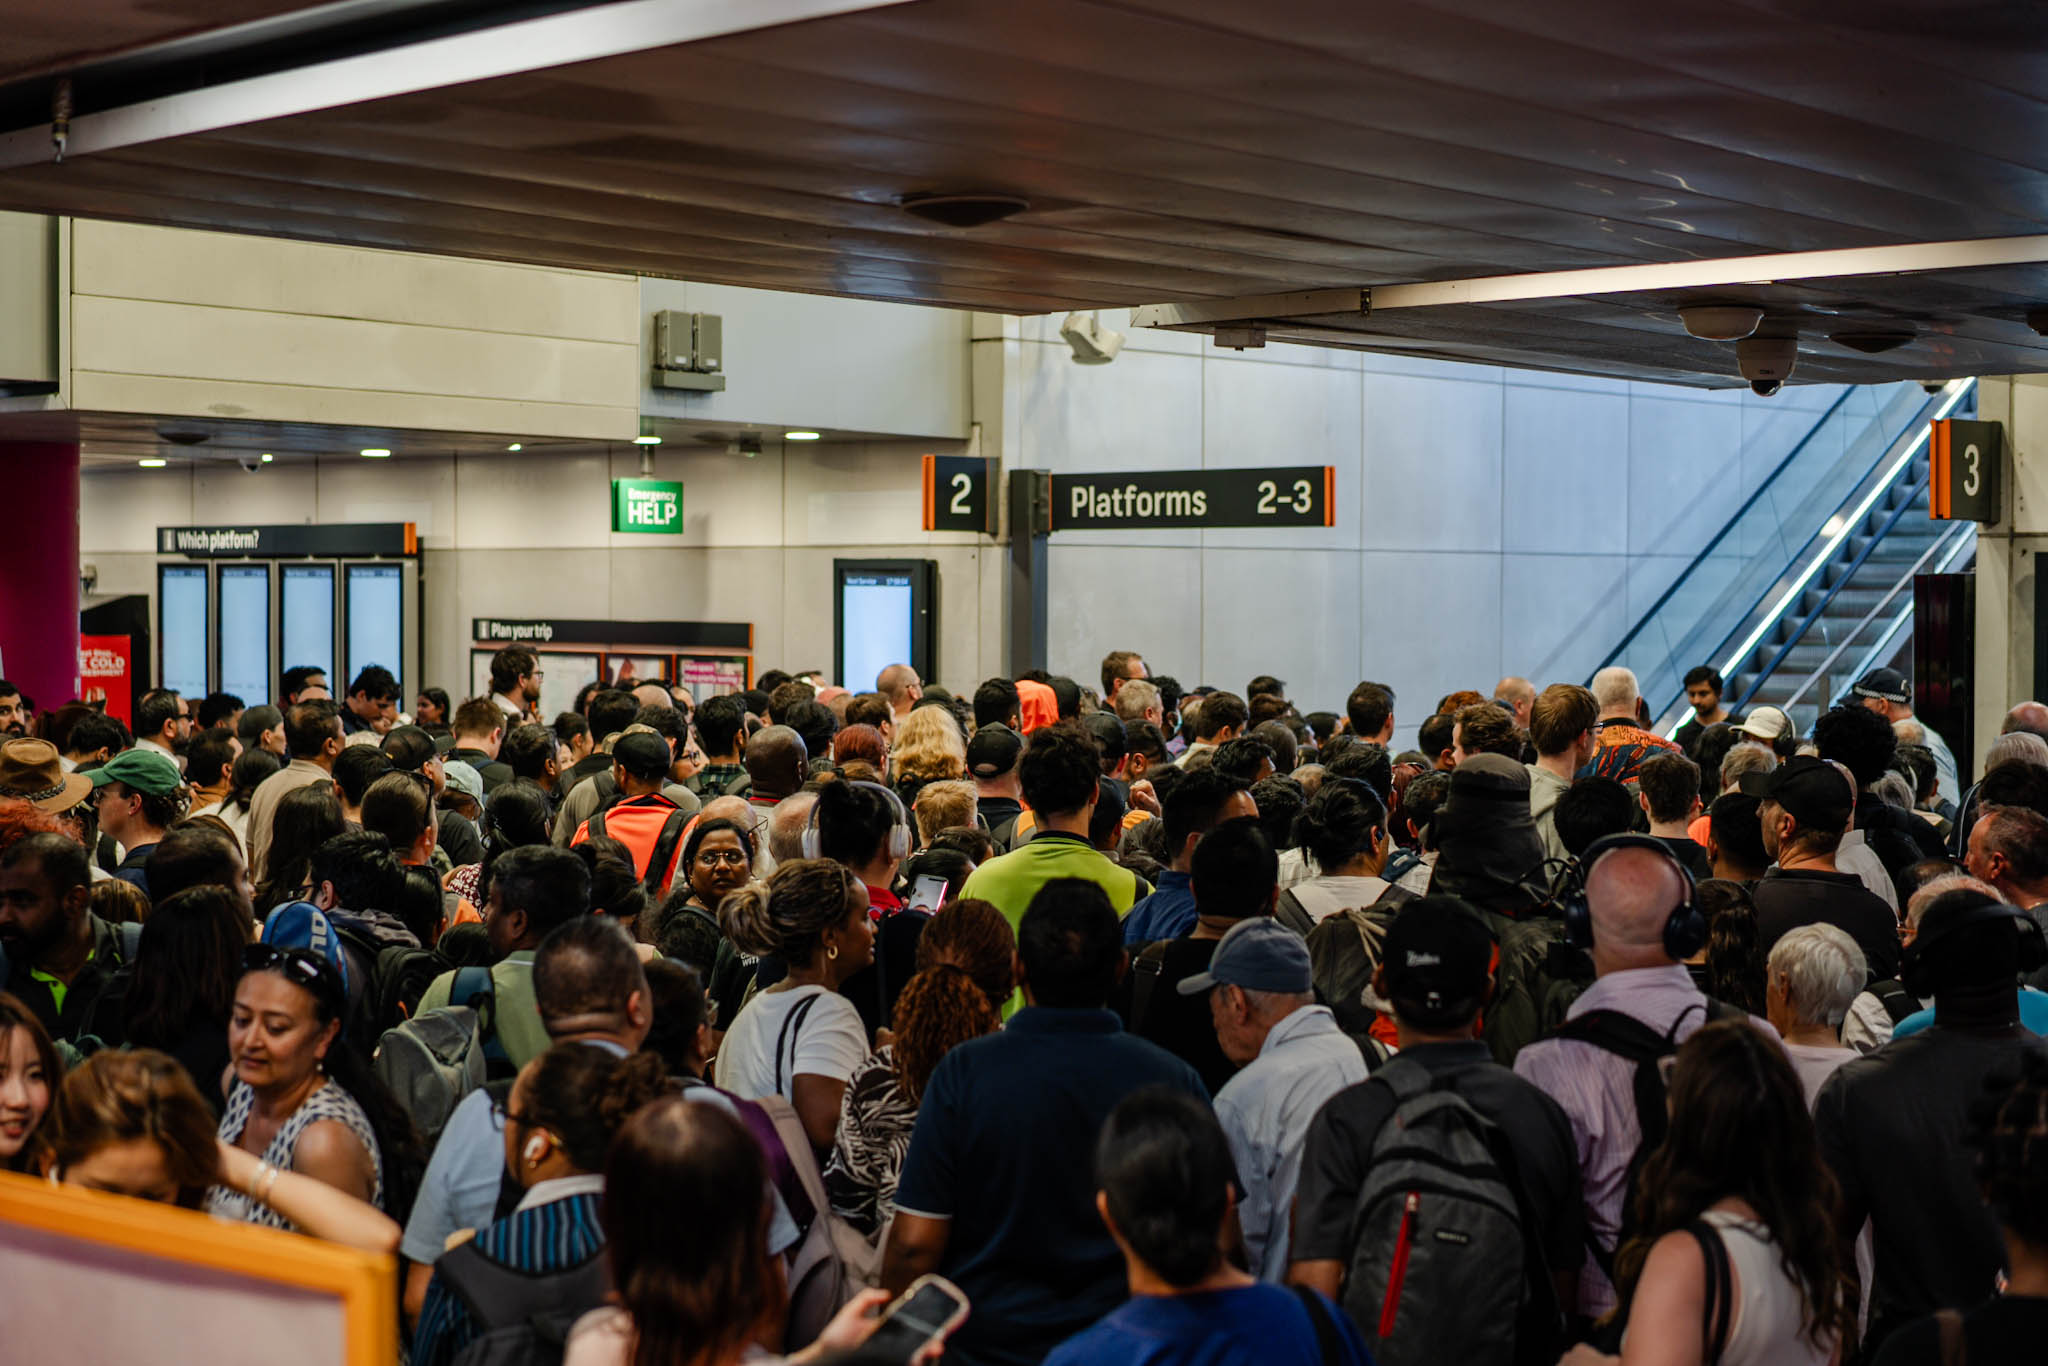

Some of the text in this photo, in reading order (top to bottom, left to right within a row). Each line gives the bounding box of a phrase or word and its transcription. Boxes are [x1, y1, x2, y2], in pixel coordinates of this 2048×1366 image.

[1963, 444, 1980, 496] 3
[628, 487, 677, 503] Emergency
[949, 472, 972, 515] 2
[1071, 479, 1313, 518] Platforms 2-3
[627, 501, 677, 525] HELP
[177, 529, 260, 553] Which platform?
[491, 621, 553, 642] Plan your trip
[90, 655, 125, 671] COLD
